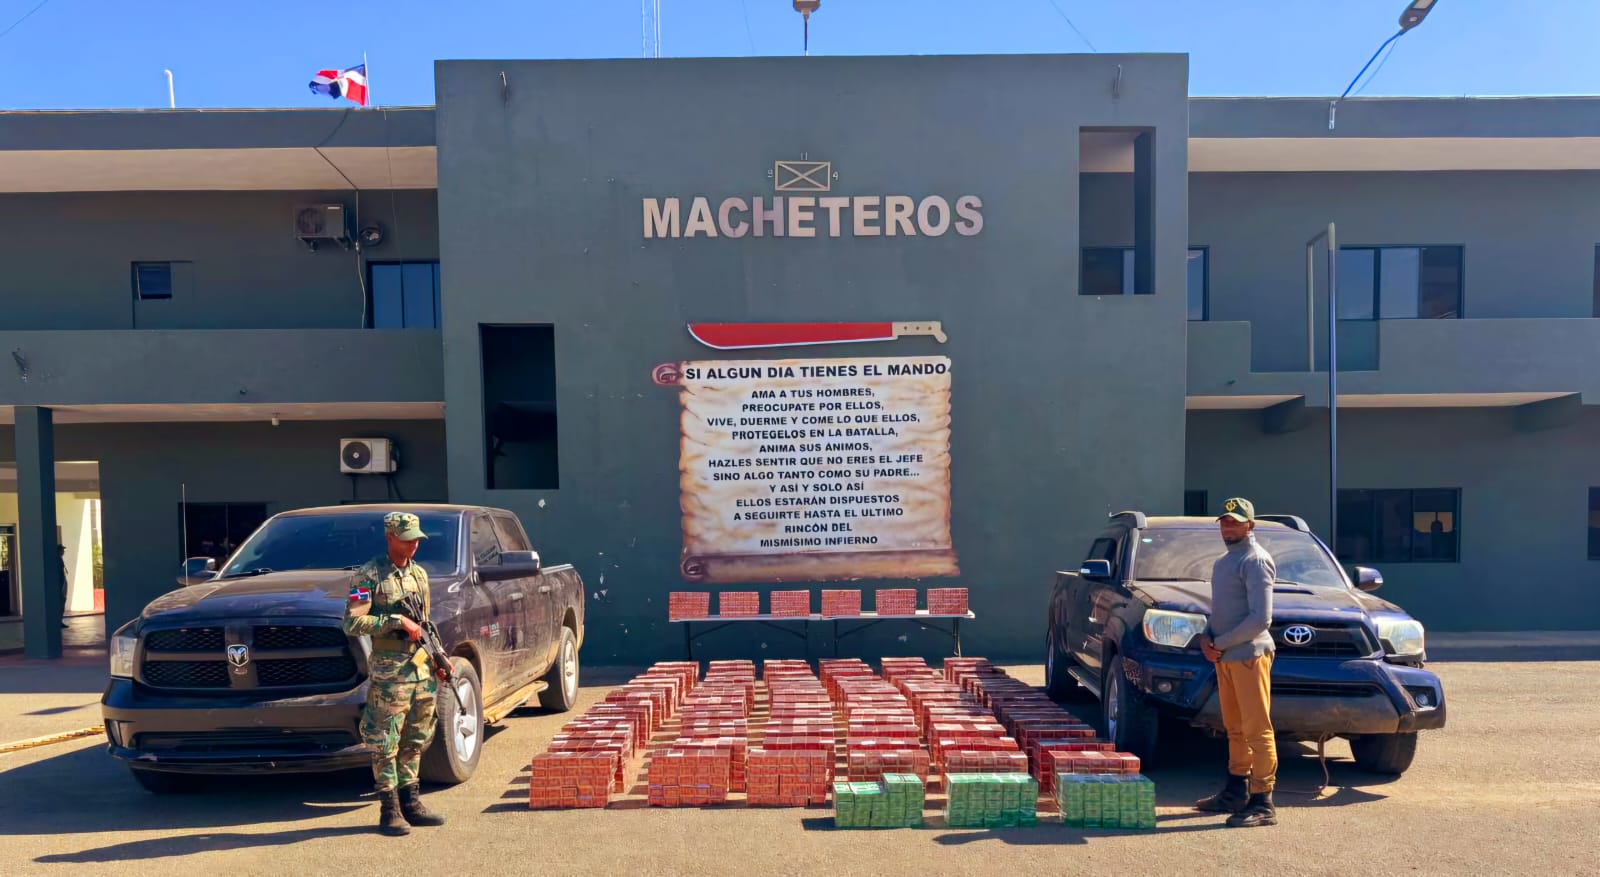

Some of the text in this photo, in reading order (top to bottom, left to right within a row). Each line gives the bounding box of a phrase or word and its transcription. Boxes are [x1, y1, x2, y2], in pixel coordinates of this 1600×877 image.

[642, 195, 984, 238] MACHETEROS
[686, 364, 946, 380] SI ALGUN DIA TIENES EL MANDO
[751, 388, 875, 399] AMA A TUS HOMBRES,
[742, 401, 884, 412] PREOCUPATE POR ELLOS,
[707, 413, 920, 427] VIVE, DUERME Y COME LO QUE ELLOS,
[732, 427, 898, 440] PROTEGELOS EN LA BATALLA,
[759, 444, 796, 453] ANIMA
[799, 443, 822, 452] SUS
[708, 454, 923, 468] HAZLES SENTIR QUE NO ERES EL JEFE
[713, 472, 740, 481] SINO
[744, 471, 774, 480] ALGO
[777, 470, 815, 479] TANTO
[818, 470, 851, 478] COMO
[855, 469, 870, 477] SU
[769, 485, 776, 493] Y
[802, 484, 809, 492] Y
[813, 483, 843, 492] SOLO
[736, 498, 771, 507] ELLOS
[830, 494, 899, 504] DISPUESTOS
[734, 508, 903, 521] A SEGUIRTE HASTA EL ULTIMO
[832, 523, 852, 532] DEL
[825, 536, 878, 545] INFIERNO
